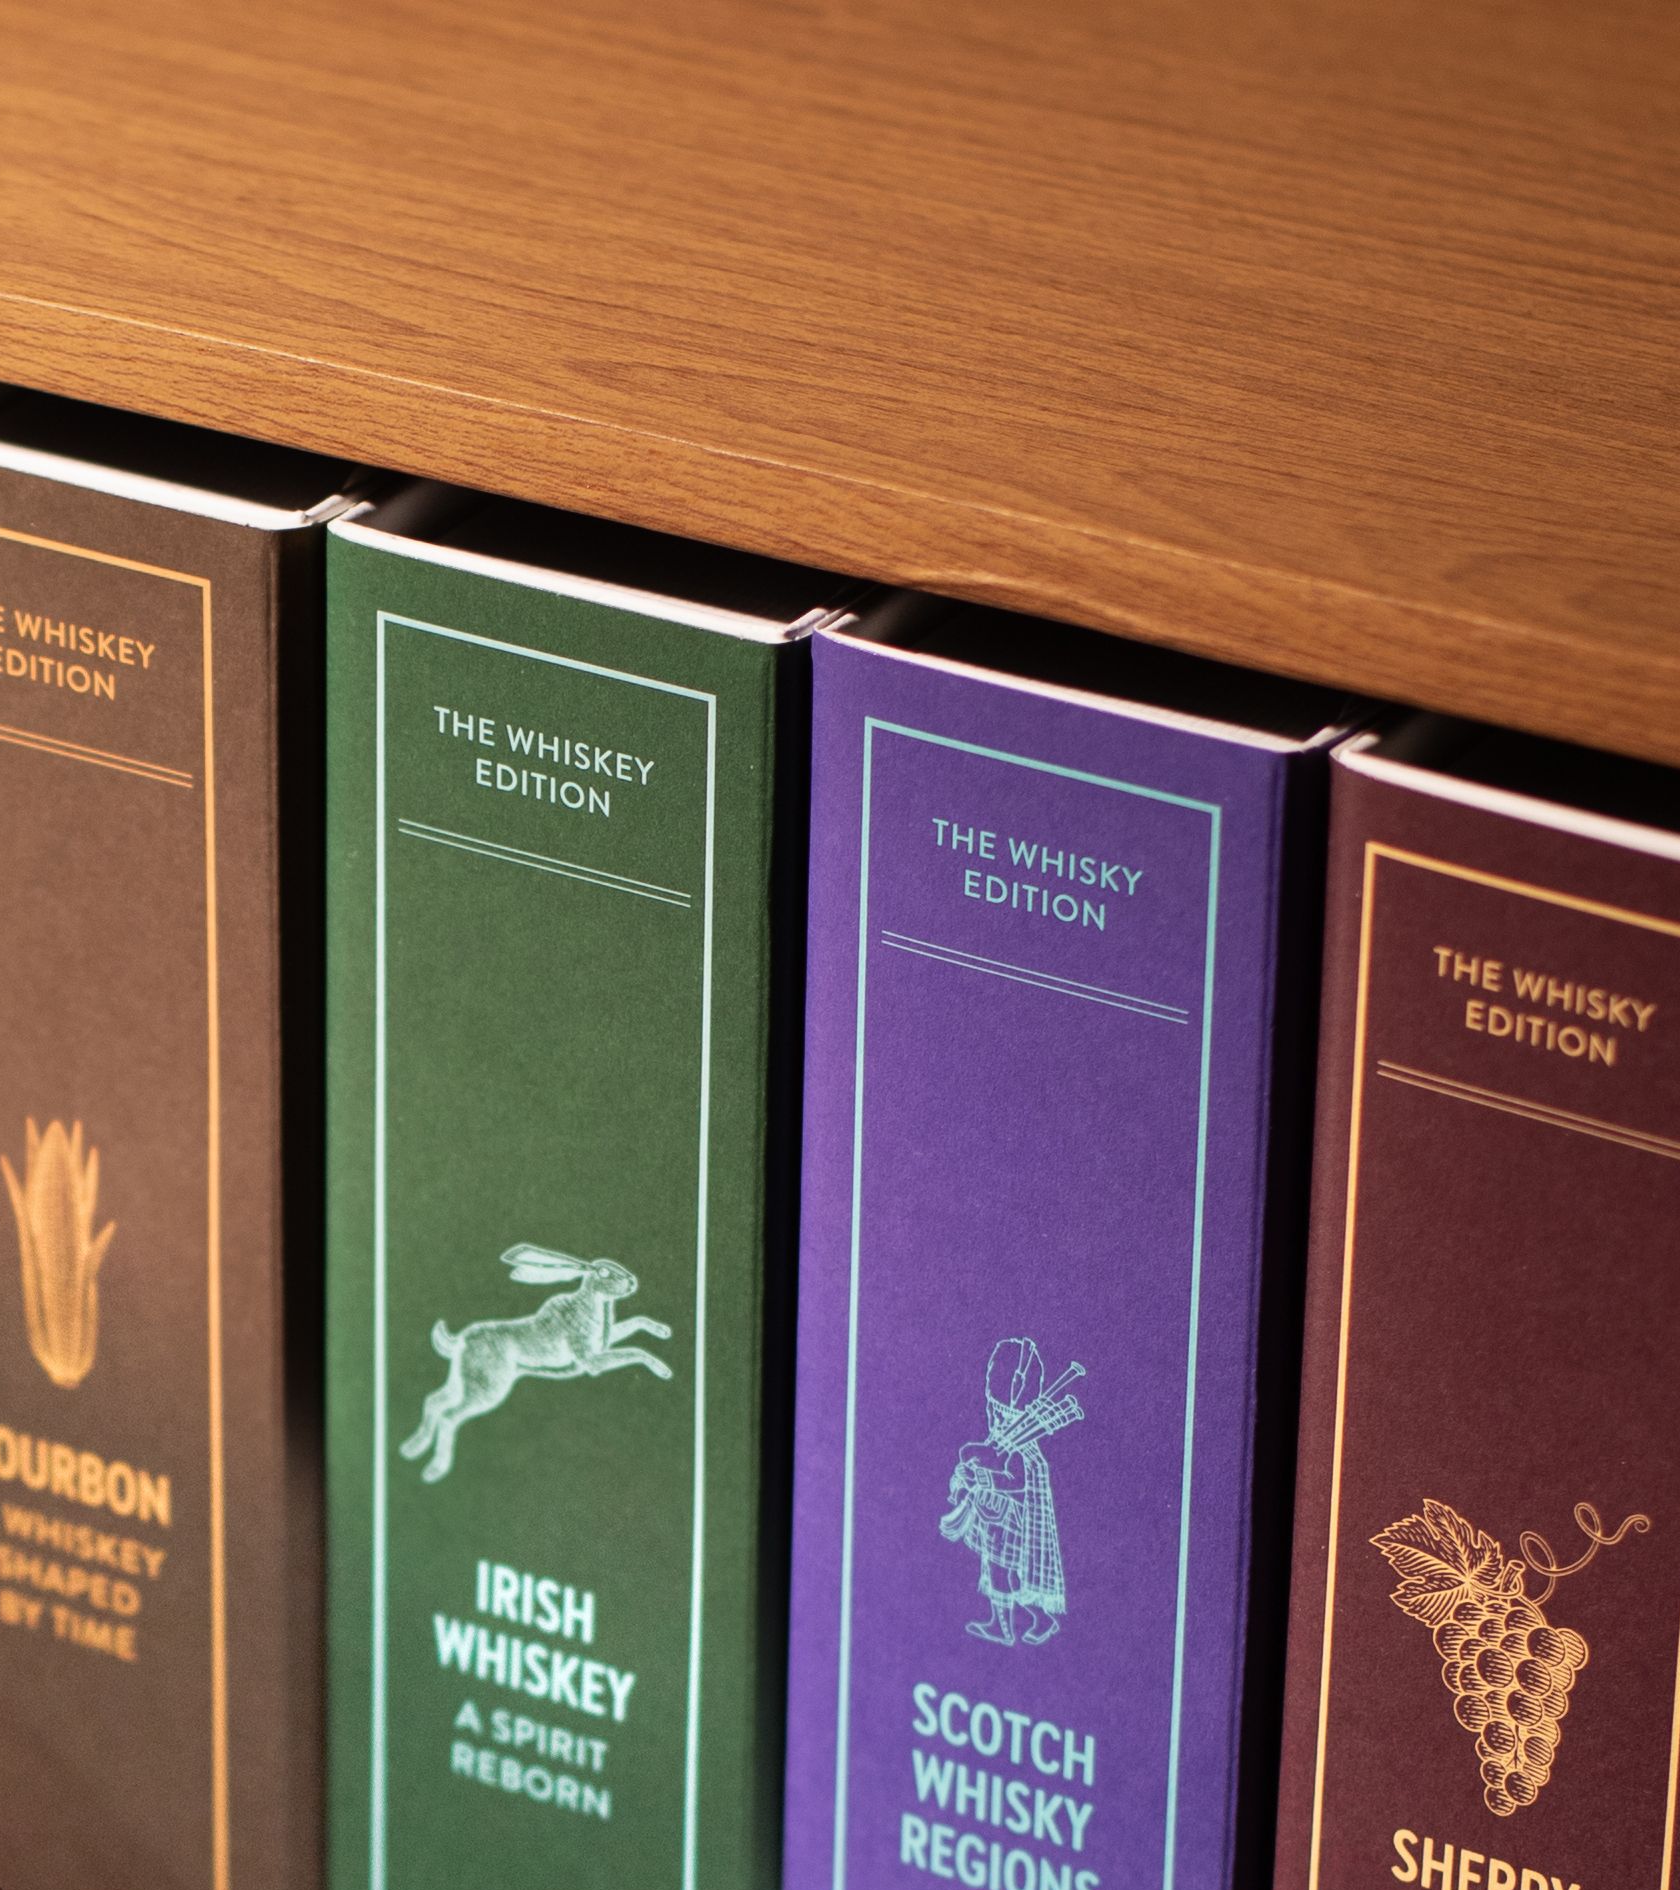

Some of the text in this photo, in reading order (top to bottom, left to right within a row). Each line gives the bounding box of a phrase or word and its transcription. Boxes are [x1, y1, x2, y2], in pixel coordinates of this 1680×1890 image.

[13, 612, 156, 671] WHISKEY
[433, 705, 656, 785] THE WHISKEY
[474, 758, 612, 817] EDITION
[931, 818, 1144, 897] THE WHISKY
[963, 870, 1107, 930] EDITION
[1431, 946, 1657, 1031] THE WHISKY
[1465, 1001, 1617, 1066] EDITION
[2, 1503, 168, 1581] WHISKEY
[51, 1603, 139, 1661] TIME
[476, 1560, 596, 1644] IRISH
[433, 1613, 636, 1722] WHISKEY
[454, 1700, 608, 1772] A SPIRIT
[911, 1683, 1096, 1786] SCOTCH
[450, 1742, 613, 1820] REBORN
[911, 1751, 1095, 1851] WHISKY
